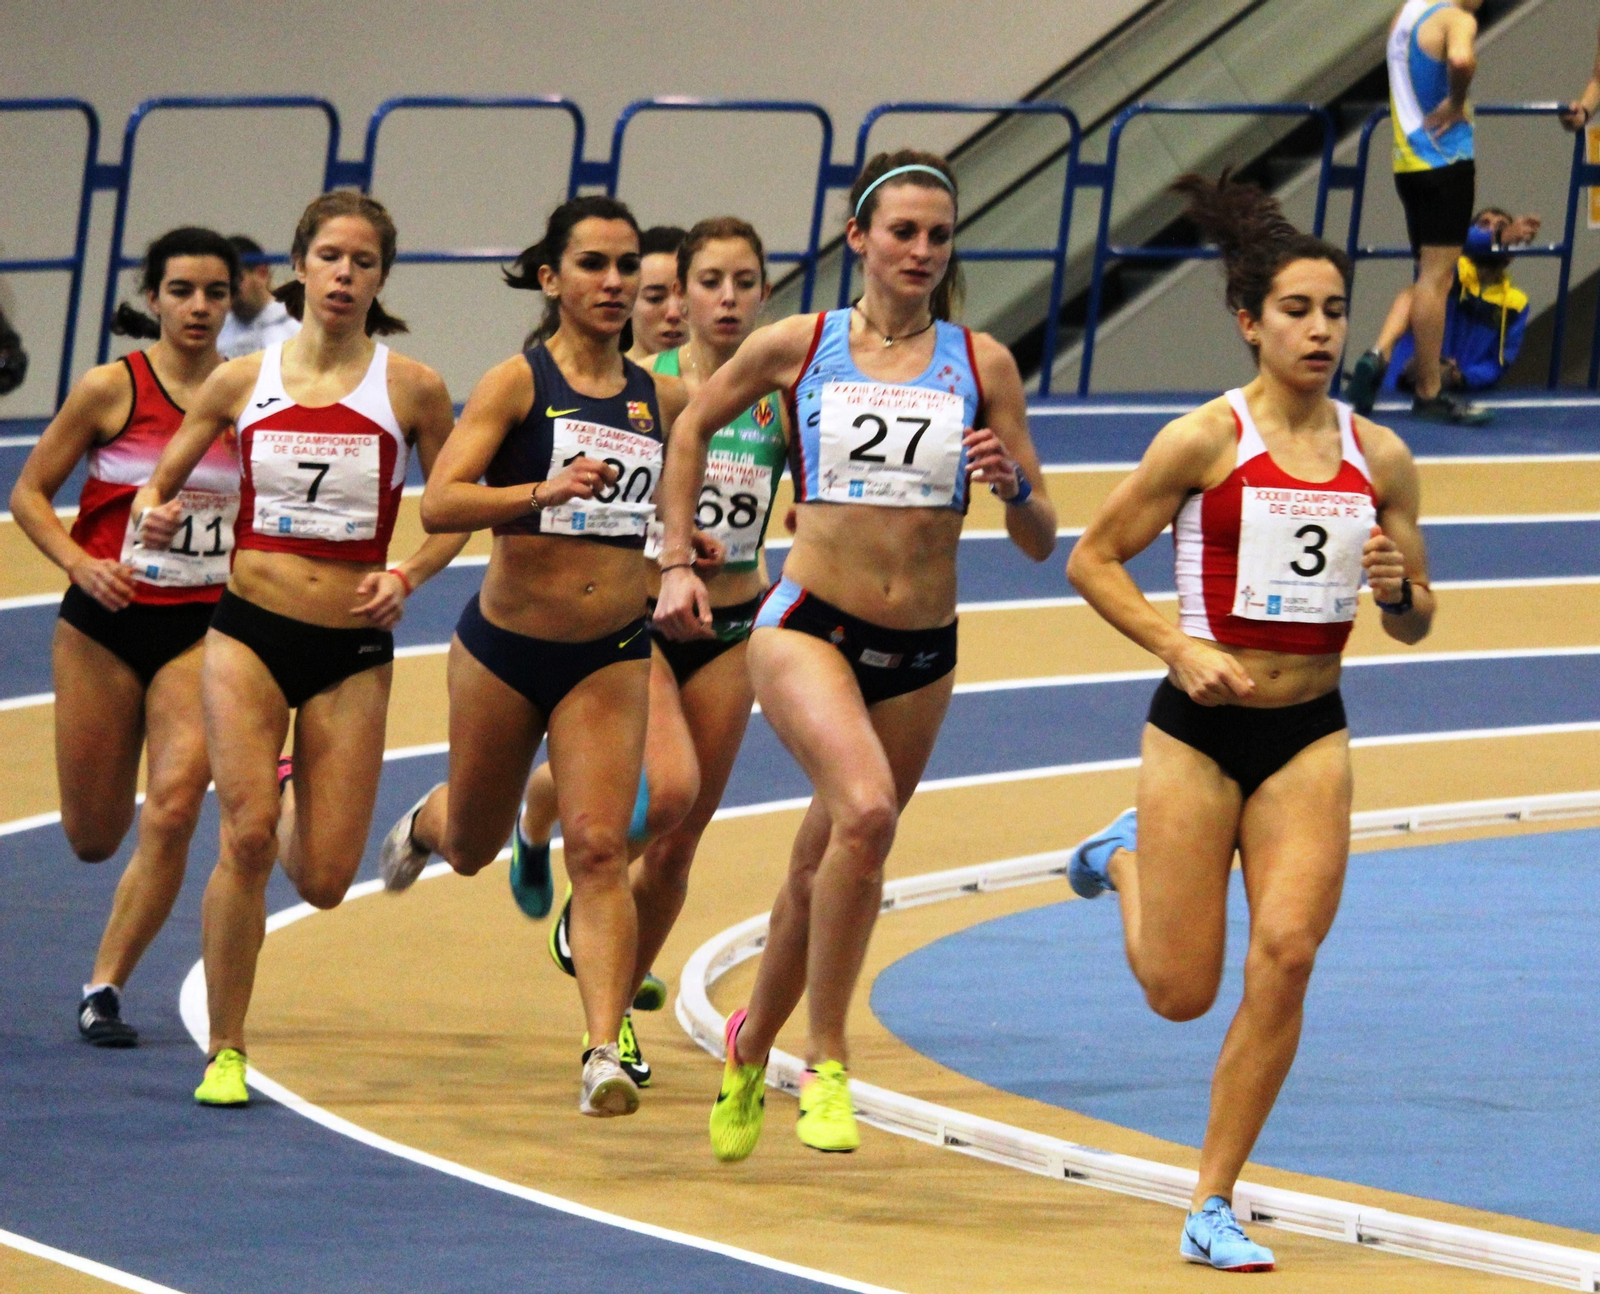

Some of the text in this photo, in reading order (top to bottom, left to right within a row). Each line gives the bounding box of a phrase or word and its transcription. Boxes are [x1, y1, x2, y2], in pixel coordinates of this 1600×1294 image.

[869, 397, 919, 409] GALICIA
[263, 434, 372, 447] XXXIII CAMPIONATO
[577, 434, 593, 446] DE
[595, 438, 636, 456] GALICIA
[850, 413, 932, 465] 27
[273, 444, 360, 457] DE GALICIA PC
[706, 461, 766, 478] MPIONATO
[298, 462, 330, 503] 7
[1256, 490, 1368, 506] XXXIII CAMPIONATO
[1269, 503, 1359, 518] DE GALICIA PC
[1290, 524, 1328, 577] 3
